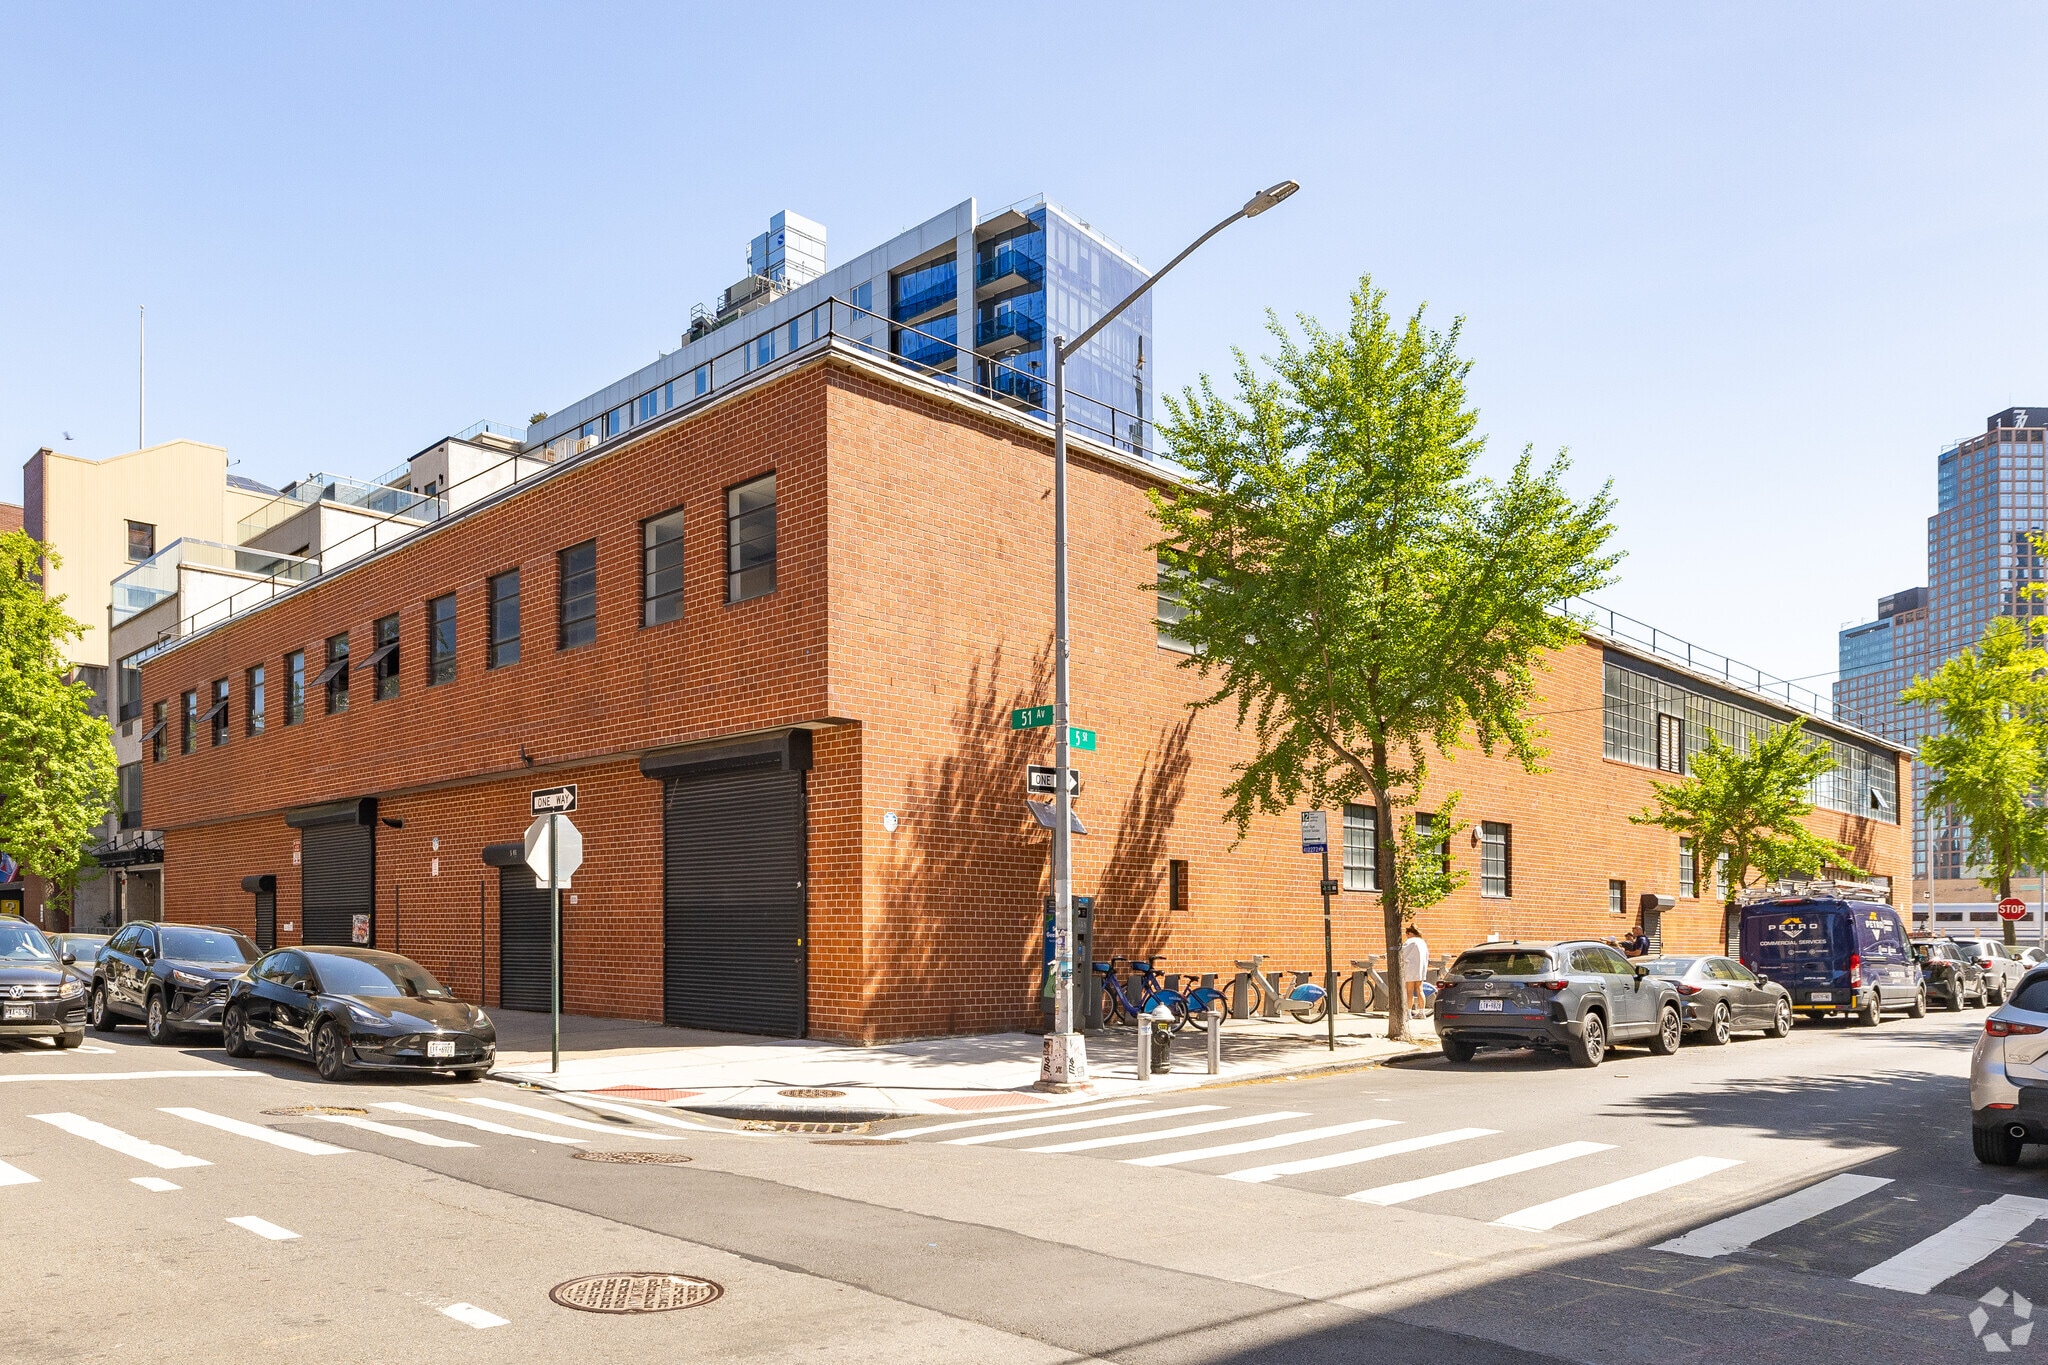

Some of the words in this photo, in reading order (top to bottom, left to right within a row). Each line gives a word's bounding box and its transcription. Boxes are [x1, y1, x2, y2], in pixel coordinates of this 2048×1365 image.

[1021, 710, 1032, 726] 51
[1036, 709, 1046, 719] Av
[1076, 731, 1080, 746] 5
[1035, 774, 1051, 786] ONE
[538, 797, 551, 807] ONE
[556, 794, 569, 804] WAY
[1999, 904, 2025, 914] STOP
[1768, 923, 1818, 931] PETRO
